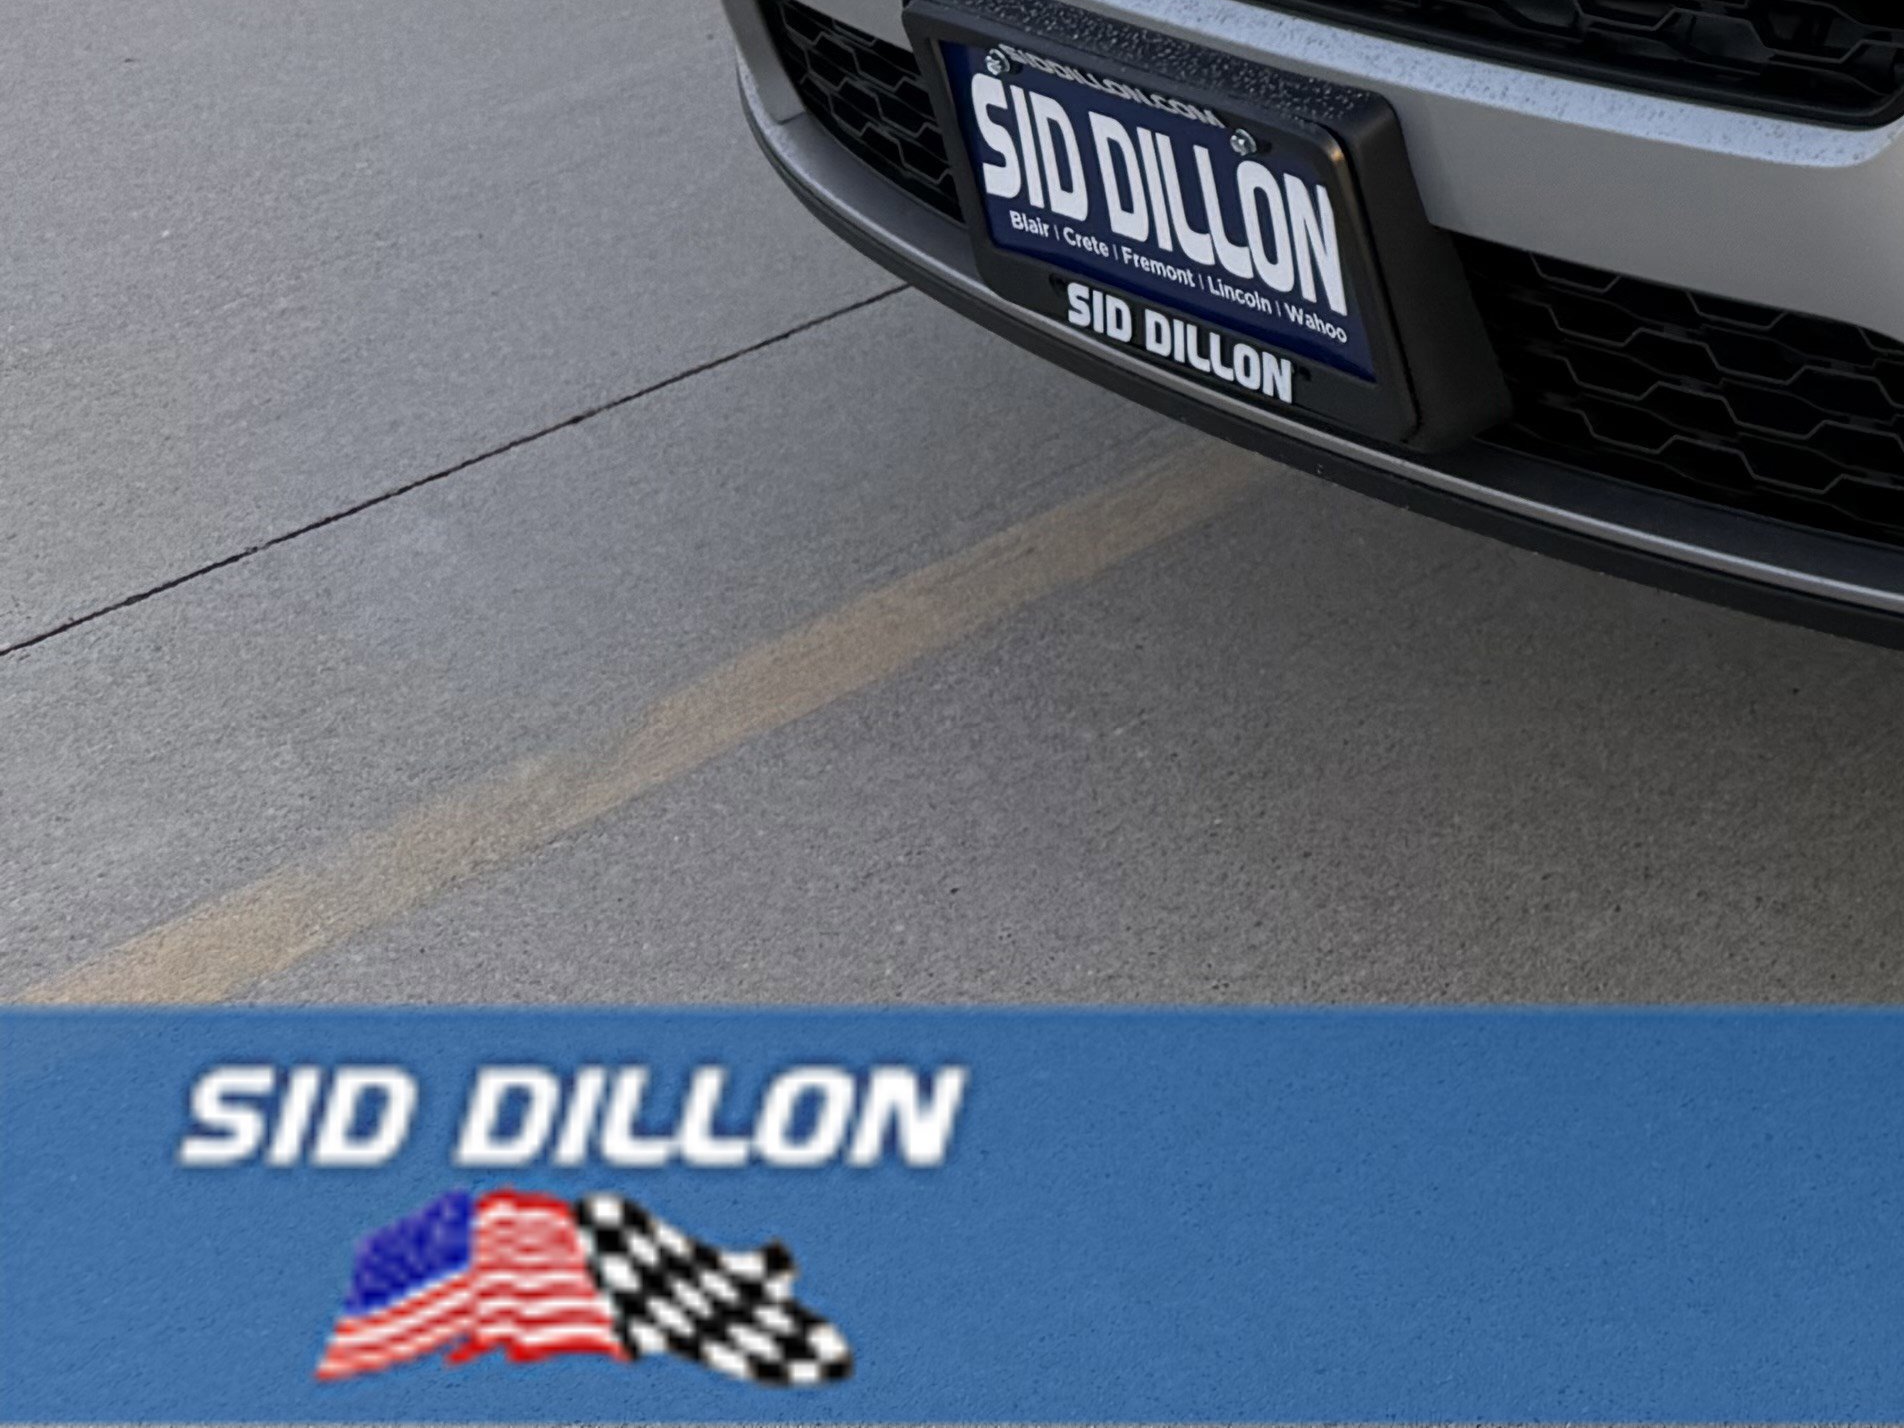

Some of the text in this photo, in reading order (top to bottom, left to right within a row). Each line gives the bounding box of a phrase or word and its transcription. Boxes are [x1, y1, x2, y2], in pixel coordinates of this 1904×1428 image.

[971, 72, 1348, 317] SID DILLON
[1009, 209, 1348, 343] Blair Crete Fremont Lincoln Wahoo
[1067, 282, 1292, 403] SID DILLON
